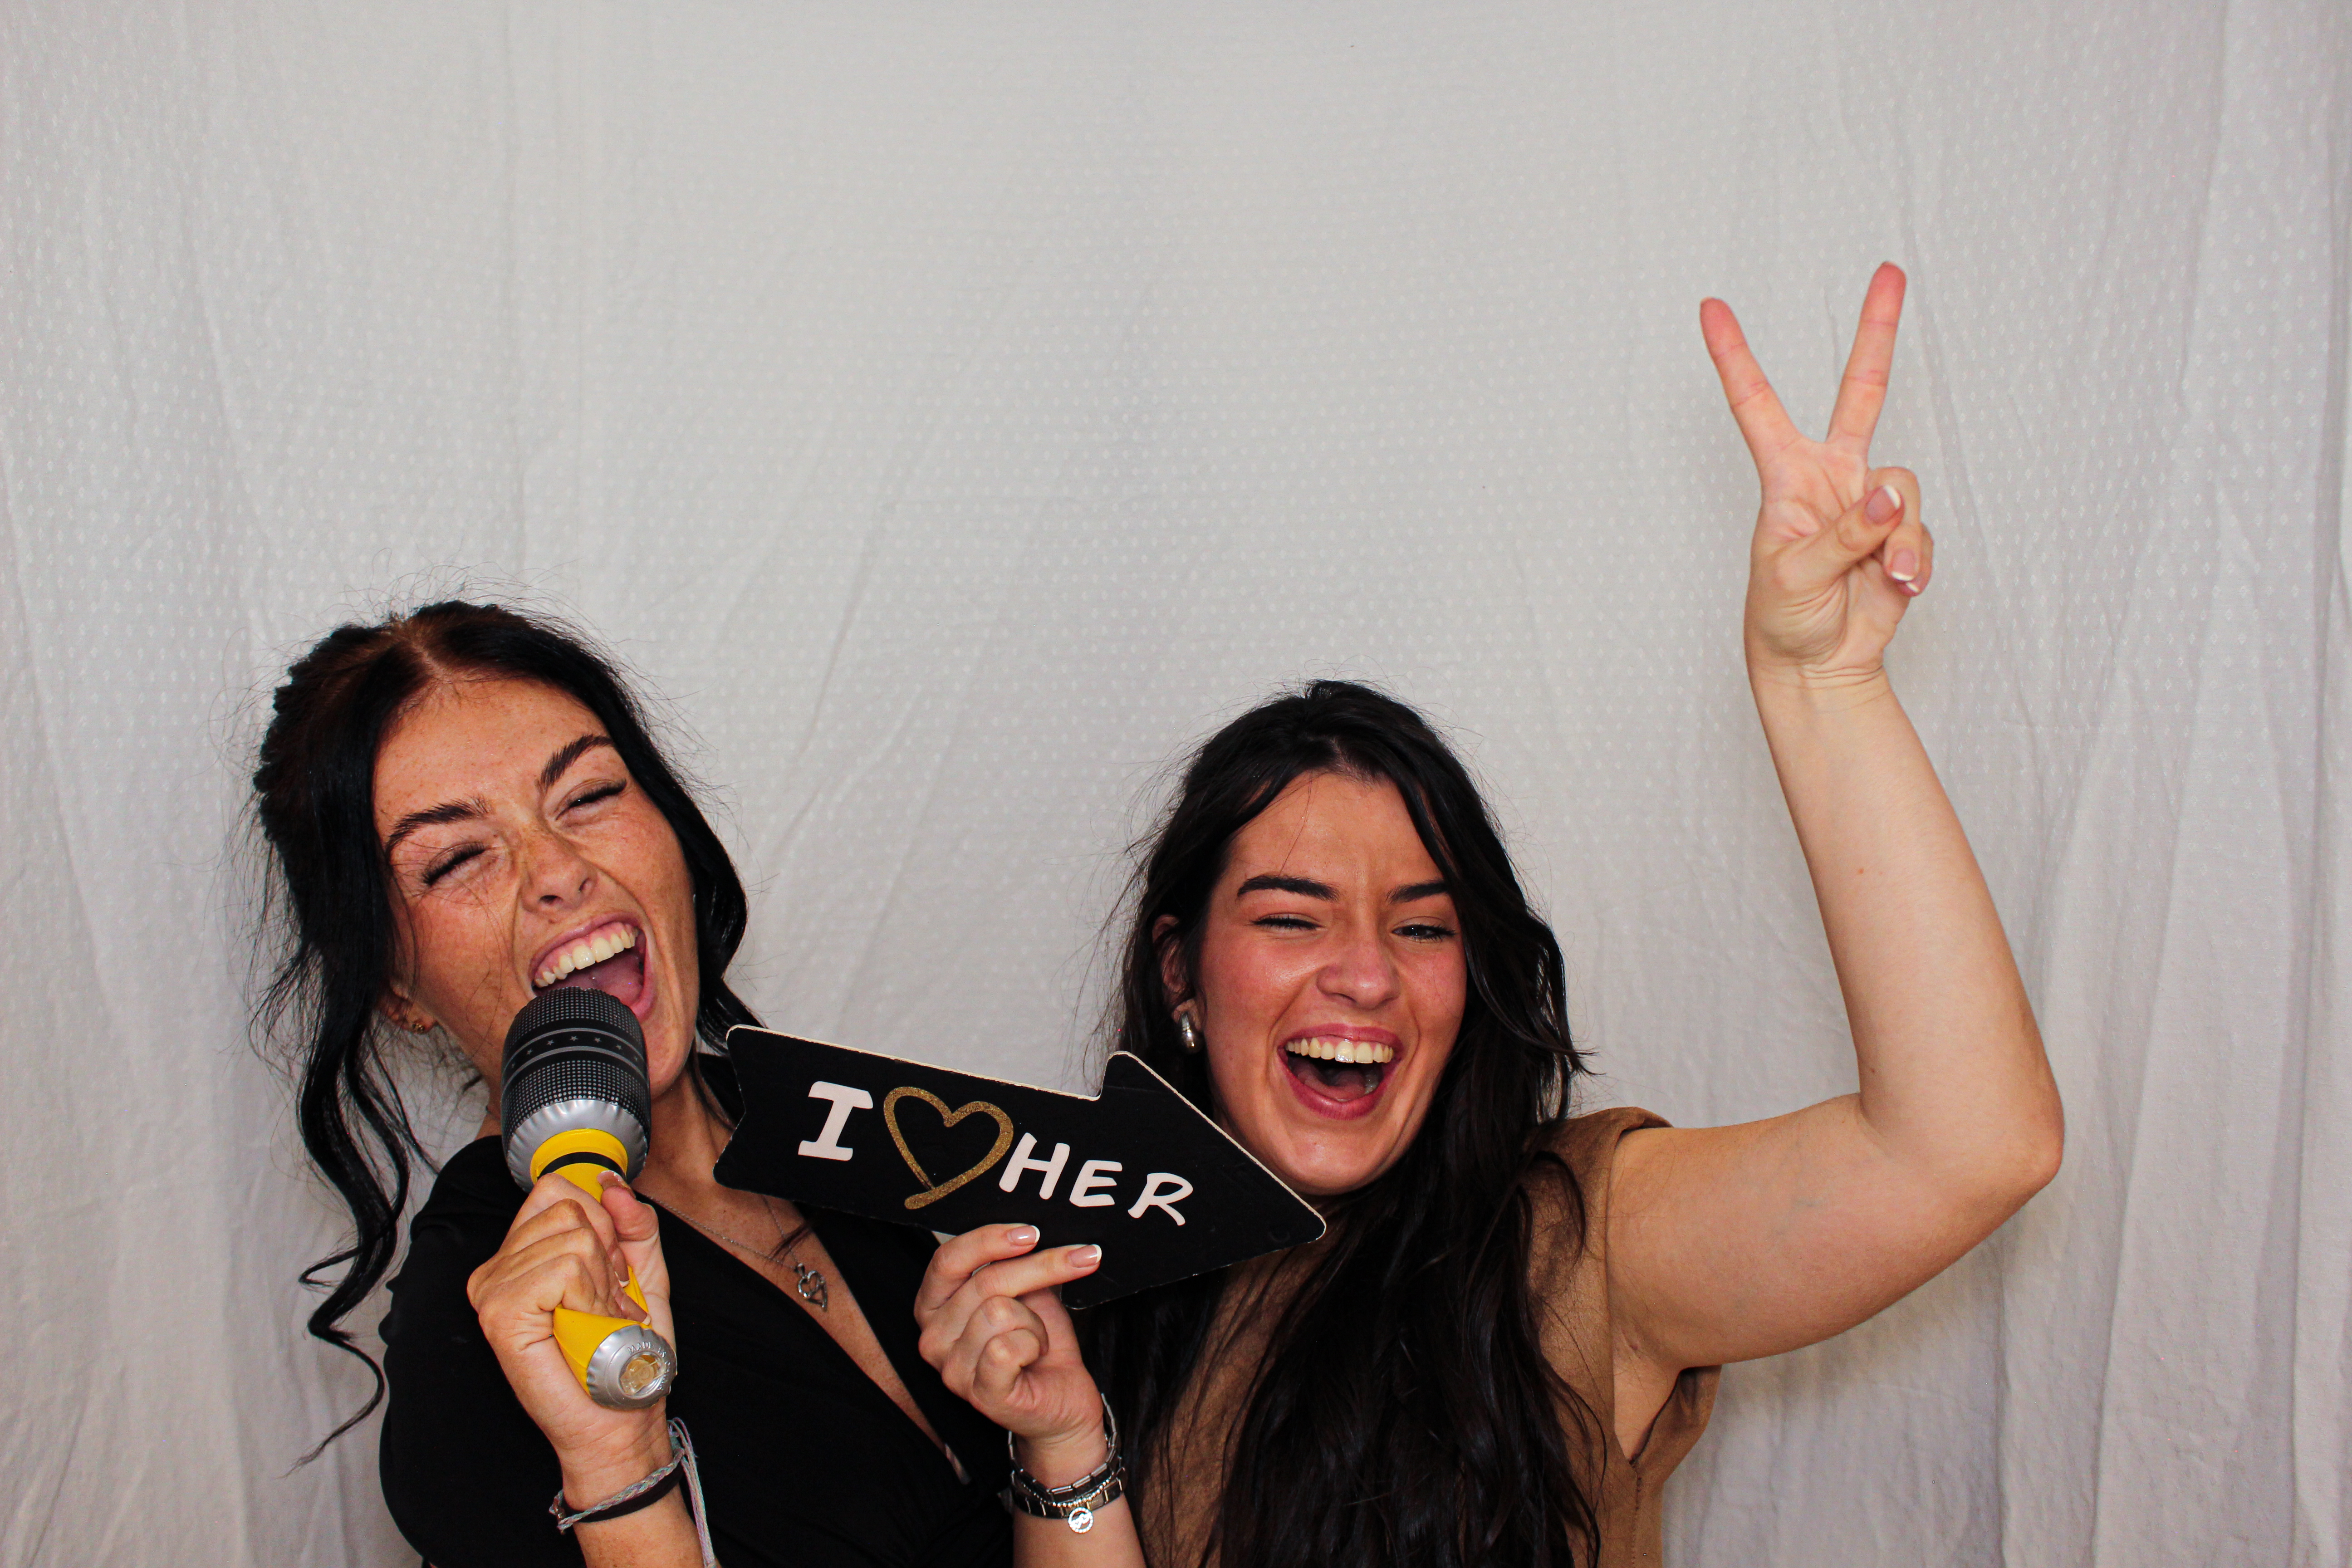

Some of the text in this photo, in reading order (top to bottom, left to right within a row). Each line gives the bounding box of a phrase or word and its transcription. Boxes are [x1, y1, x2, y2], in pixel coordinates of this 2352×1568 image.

[798, 1081, 1194, 1226] I HER
[627, 1341, 653, 1355] MADE
